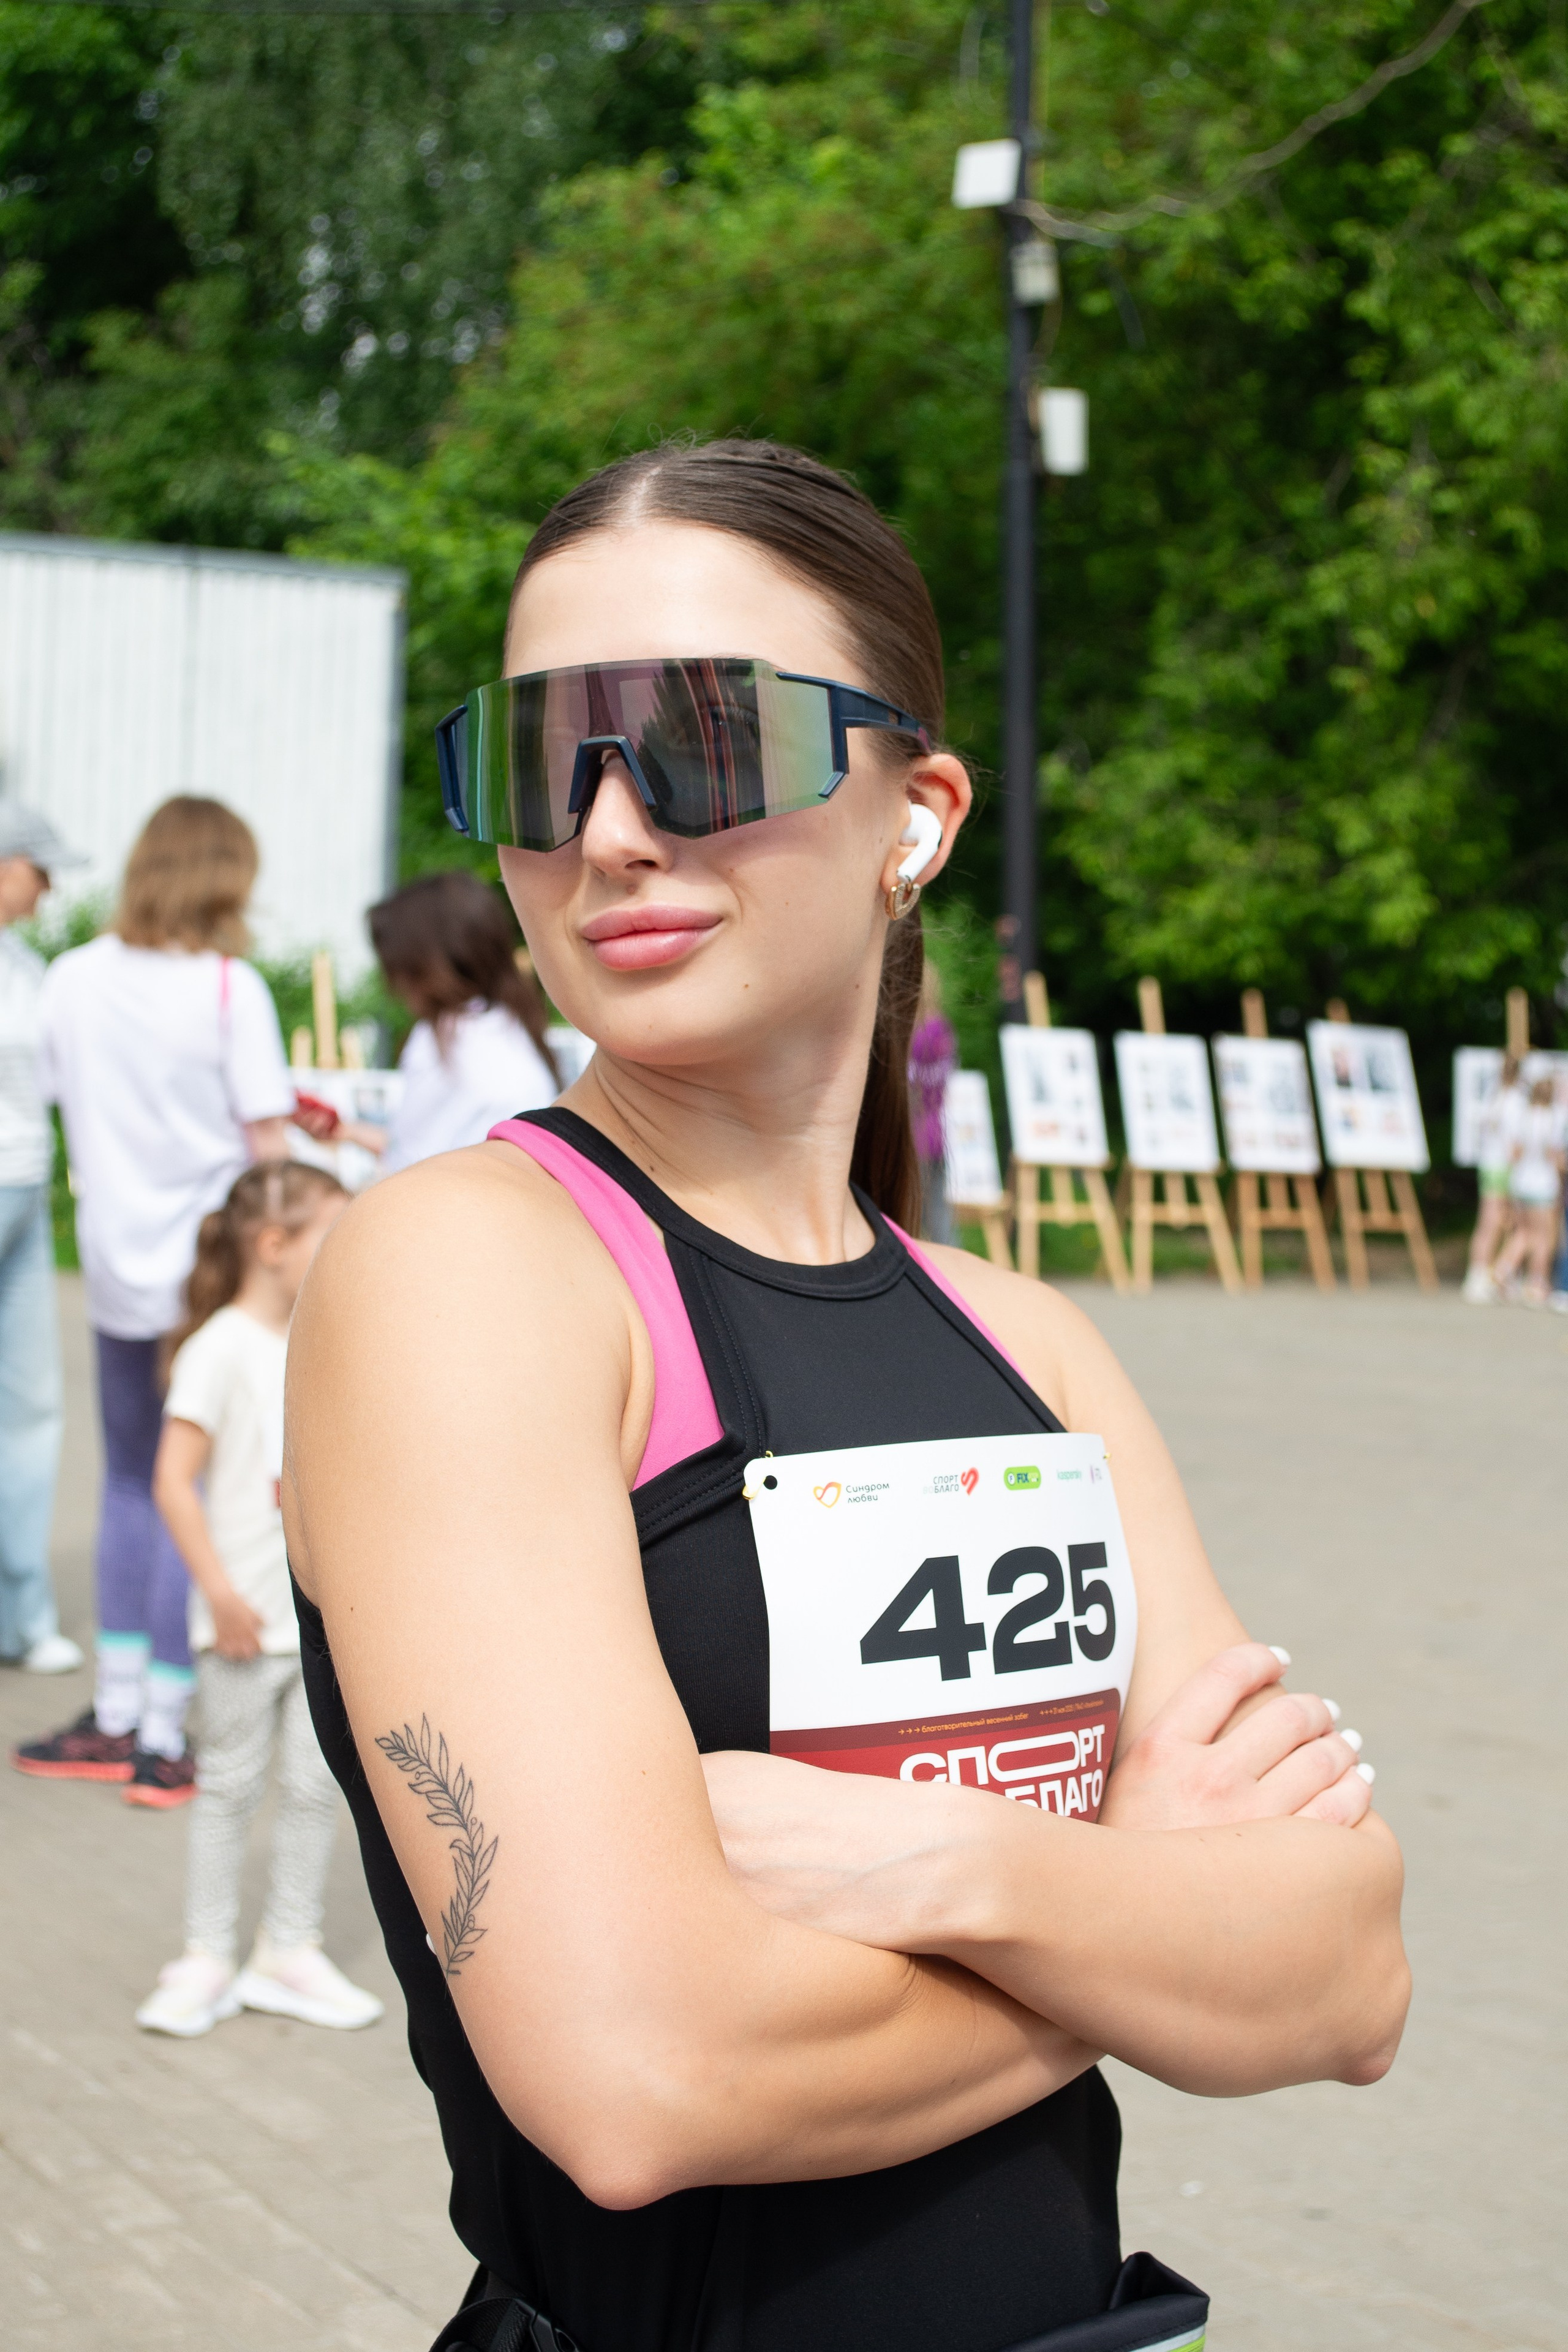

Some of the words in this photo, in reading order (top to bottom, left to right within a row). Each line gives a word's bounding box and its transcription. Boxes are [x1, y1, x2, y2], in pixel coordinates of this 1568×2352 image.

[933, 1475, 959, 1485] СПОРТ
[846, 1482, 889, 1493] Синдром
[848, 1494, 878, 1503] любви
[860, 1542, 1116, 1681] 425
[899, 1724, 1105, 1785] СПОРТ
